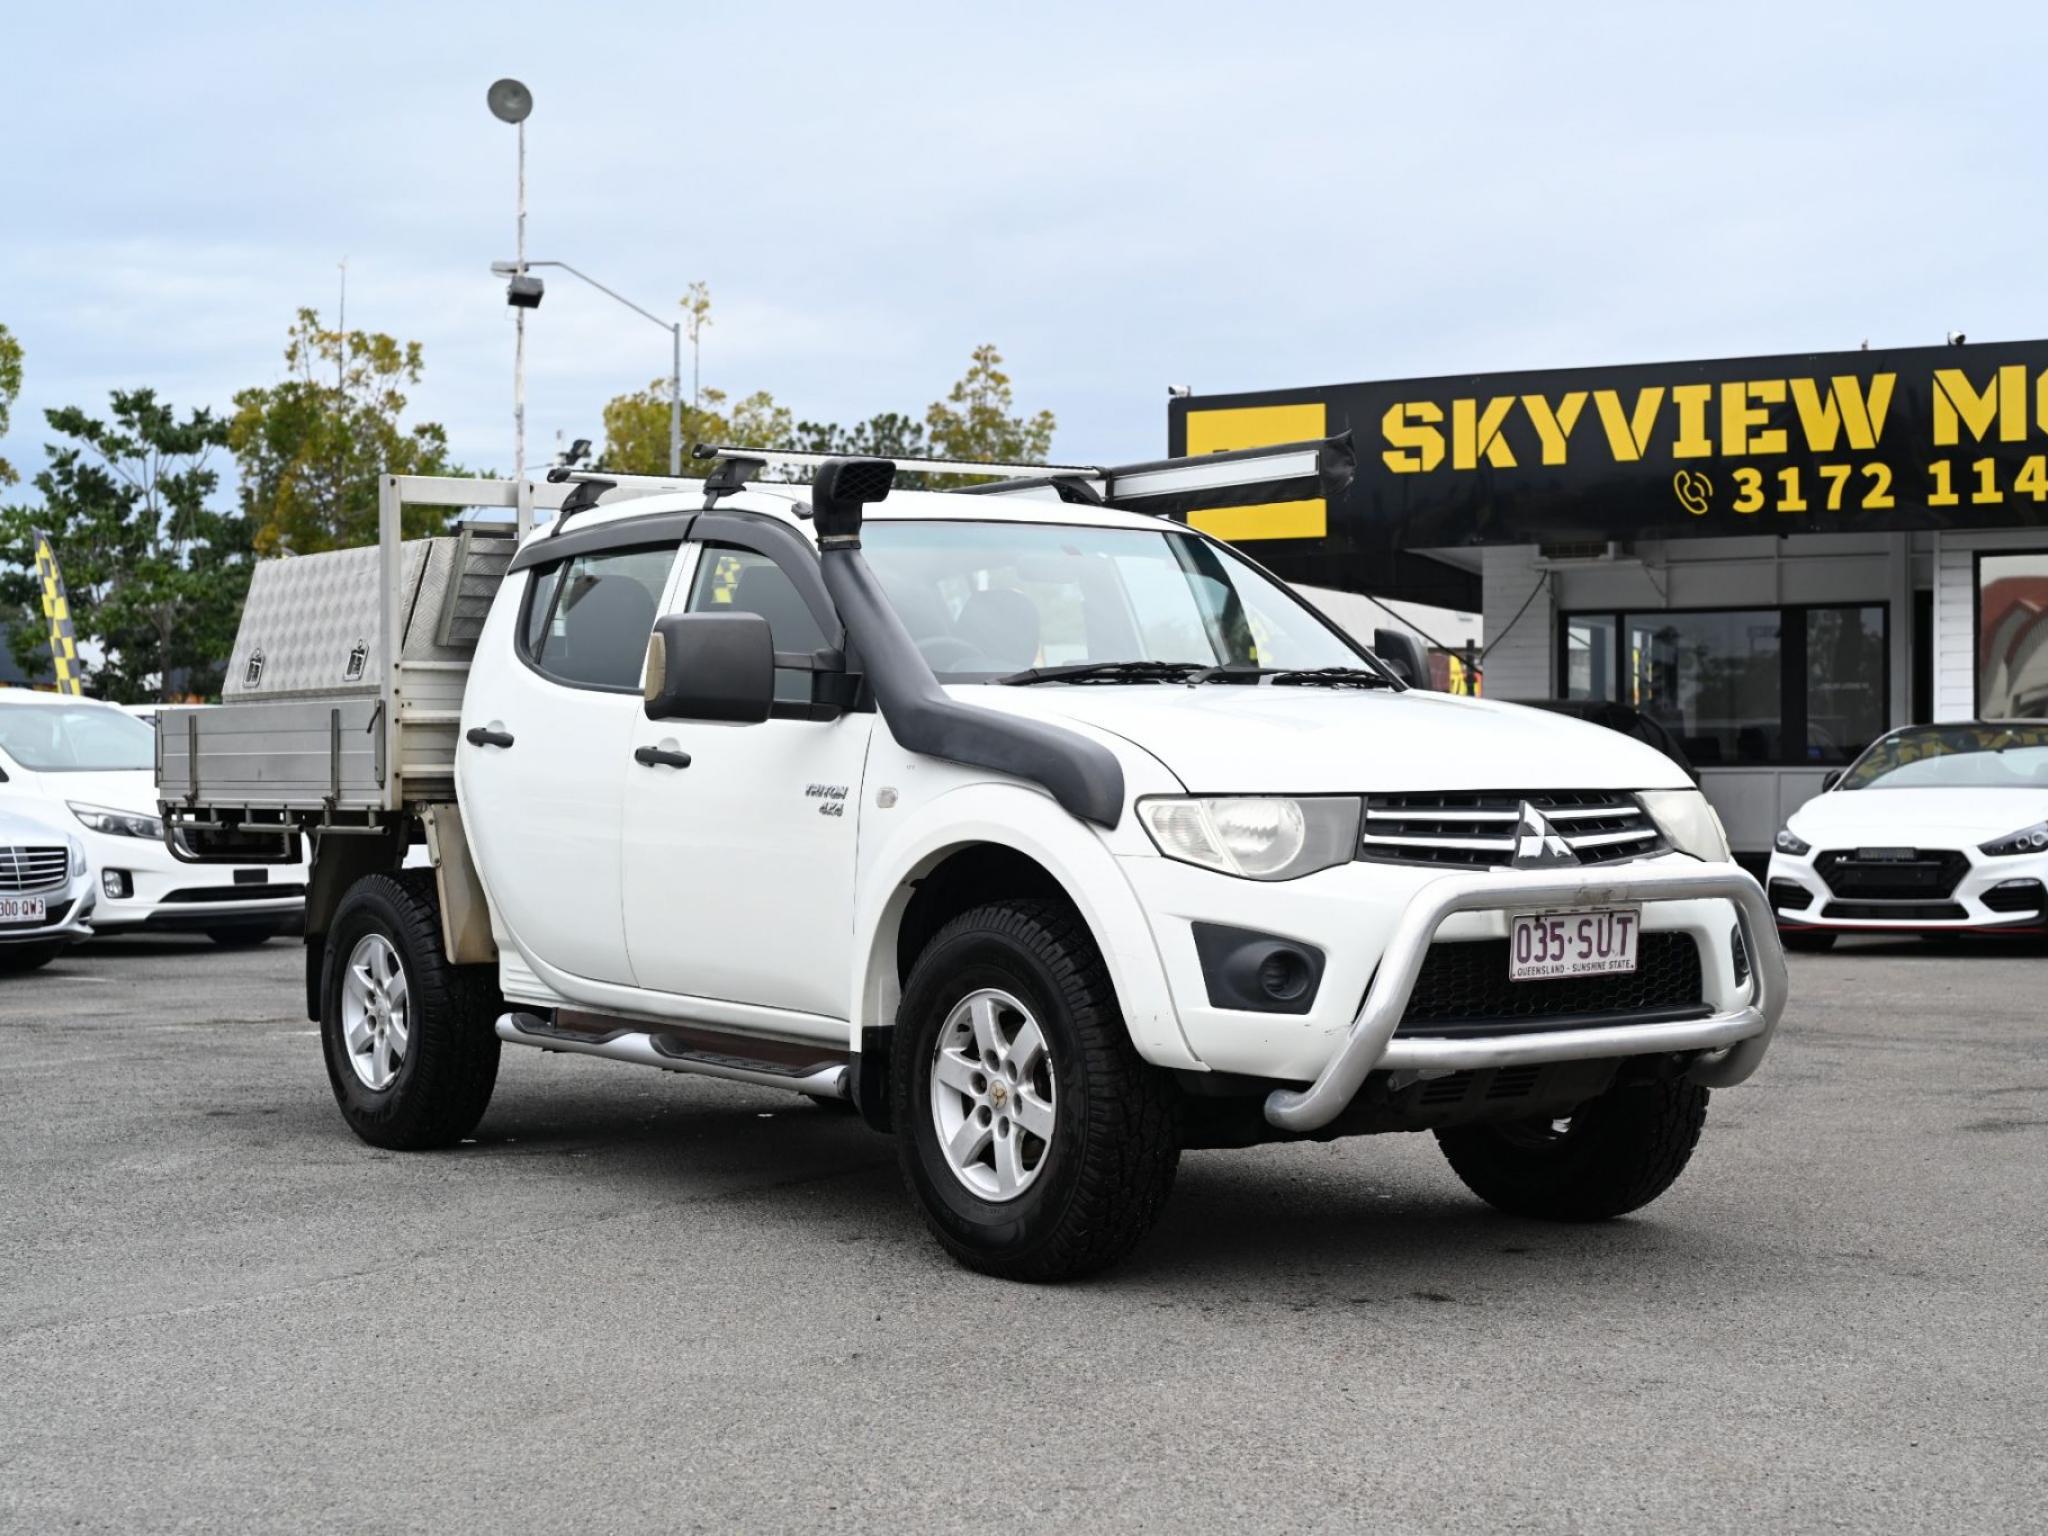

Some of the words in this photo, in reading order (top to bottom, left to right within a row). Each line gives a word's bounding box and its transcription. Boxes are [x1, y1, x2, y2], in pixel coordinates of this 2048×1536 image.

[1382, 373, 1897, 473] SKYVIEW
[1933, 365, 2048, 446] M
[1732, 463, 1895, 513] 3172
[1928, 455, 2048, 506] 114
[1517, 964, 1565, 977] QUEENSLAND
[1572, 960, 1606, 973] SUNSHINE
[1608, 959, 1631, 970] STATE
